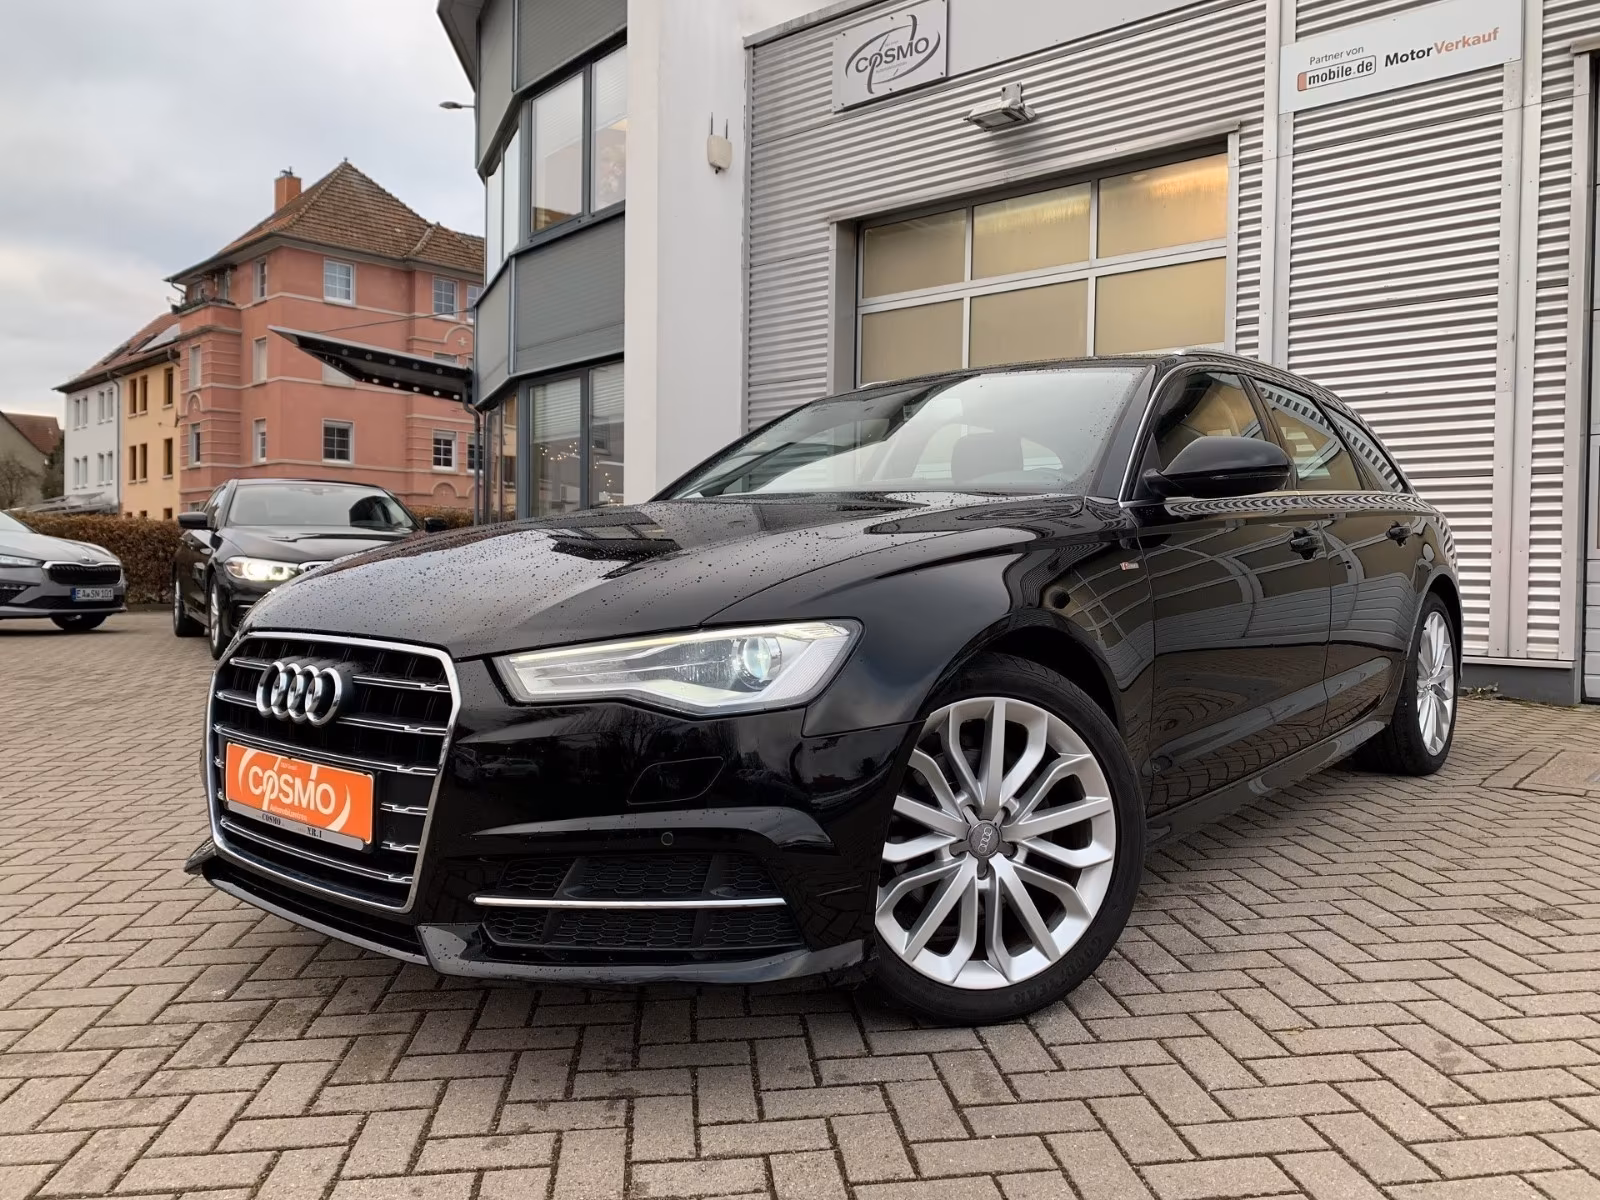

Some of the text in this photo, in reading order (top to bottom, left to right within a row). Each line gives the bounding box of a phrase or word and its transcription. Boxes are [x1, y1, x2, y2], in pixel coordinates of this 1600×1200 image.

[855, 37, 929, 73] COSMO
[1309, 46, 1364, 66] Partner von
[1307, 59, 1374, 86] mobile.de
[248, 765, 336, 815] COSMO
[261, 812, 282, 826] COSMO
